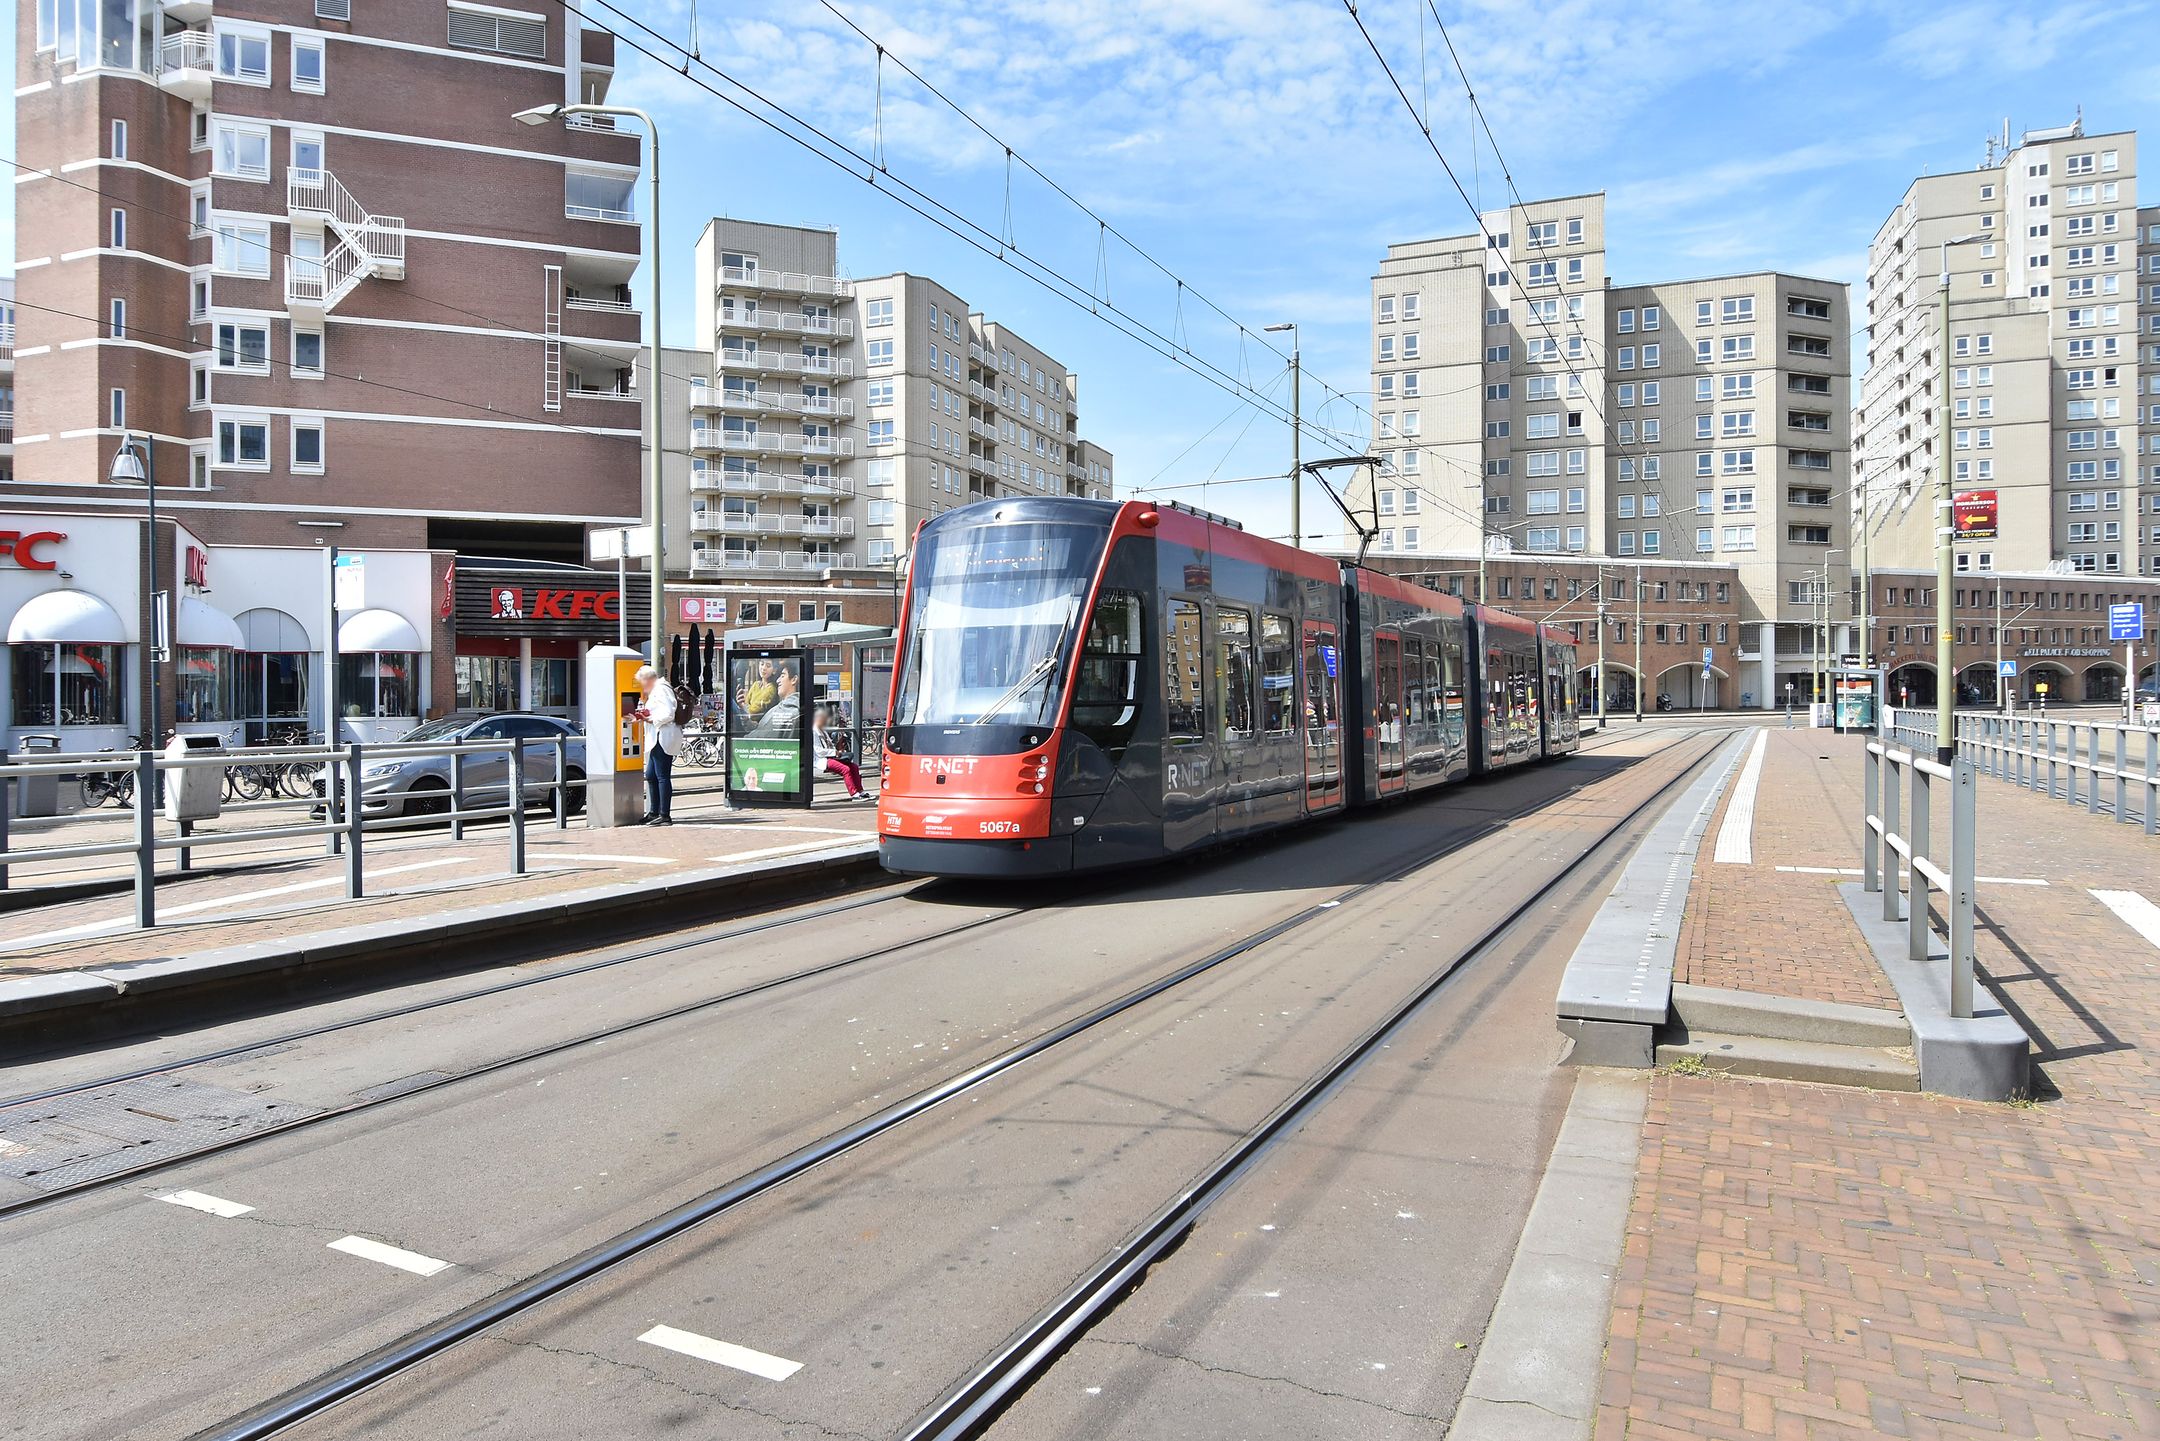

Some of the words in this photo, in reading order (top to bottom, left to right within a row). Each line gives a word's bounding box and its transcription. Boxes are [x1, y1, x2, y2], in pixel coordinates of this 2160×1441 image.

[192, 547, 209, 587] KFC
[529, 589, 620, 620] KFC
[2040, 648, 2062, 656] PALACE
[887, 815, 902, 825] HTM
[979, 821, 1020, 834] 5067a
